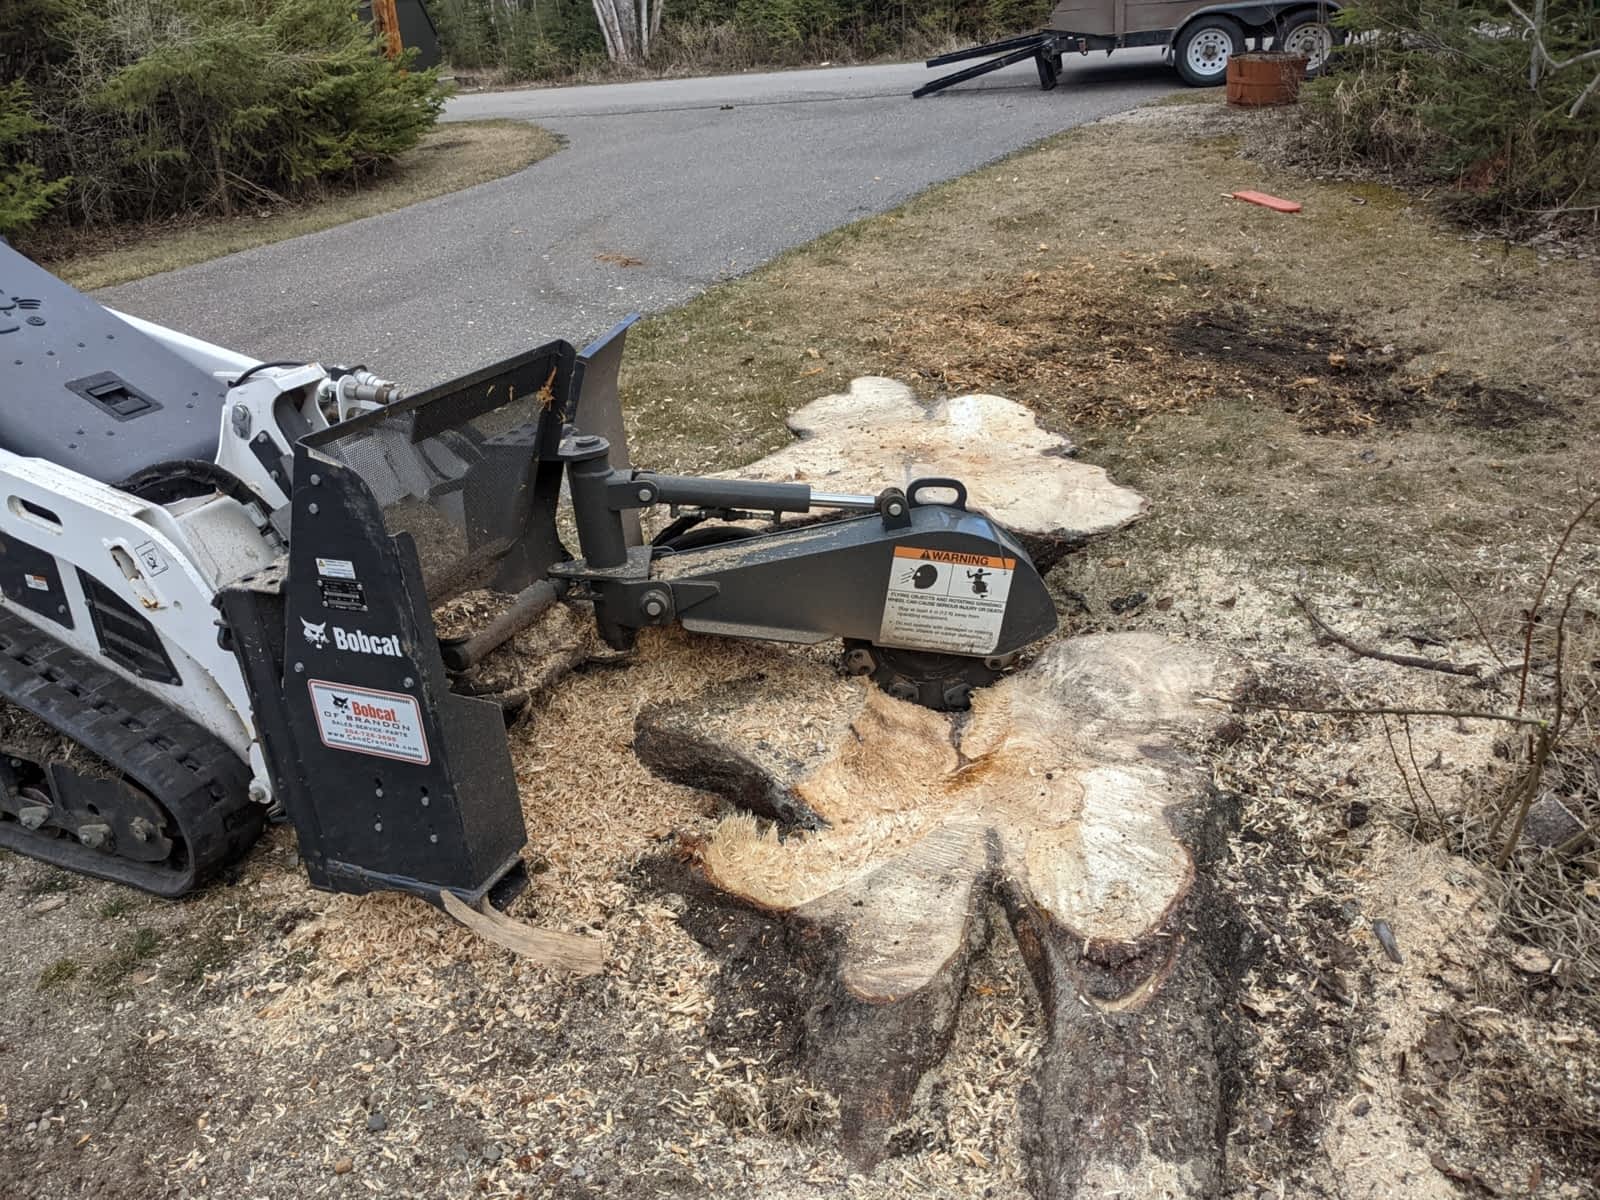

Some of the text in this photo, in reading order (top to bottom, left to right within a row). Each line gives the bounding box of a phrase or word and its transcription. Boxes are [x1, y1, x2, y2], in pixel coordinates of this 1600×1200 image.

[932, 551, 989, 566] WARNING
[332, 627, 403, 657] Bobcat
[351, 701, 398, 722] Bobcat
[346, 715, 411, 731] BRANDON
